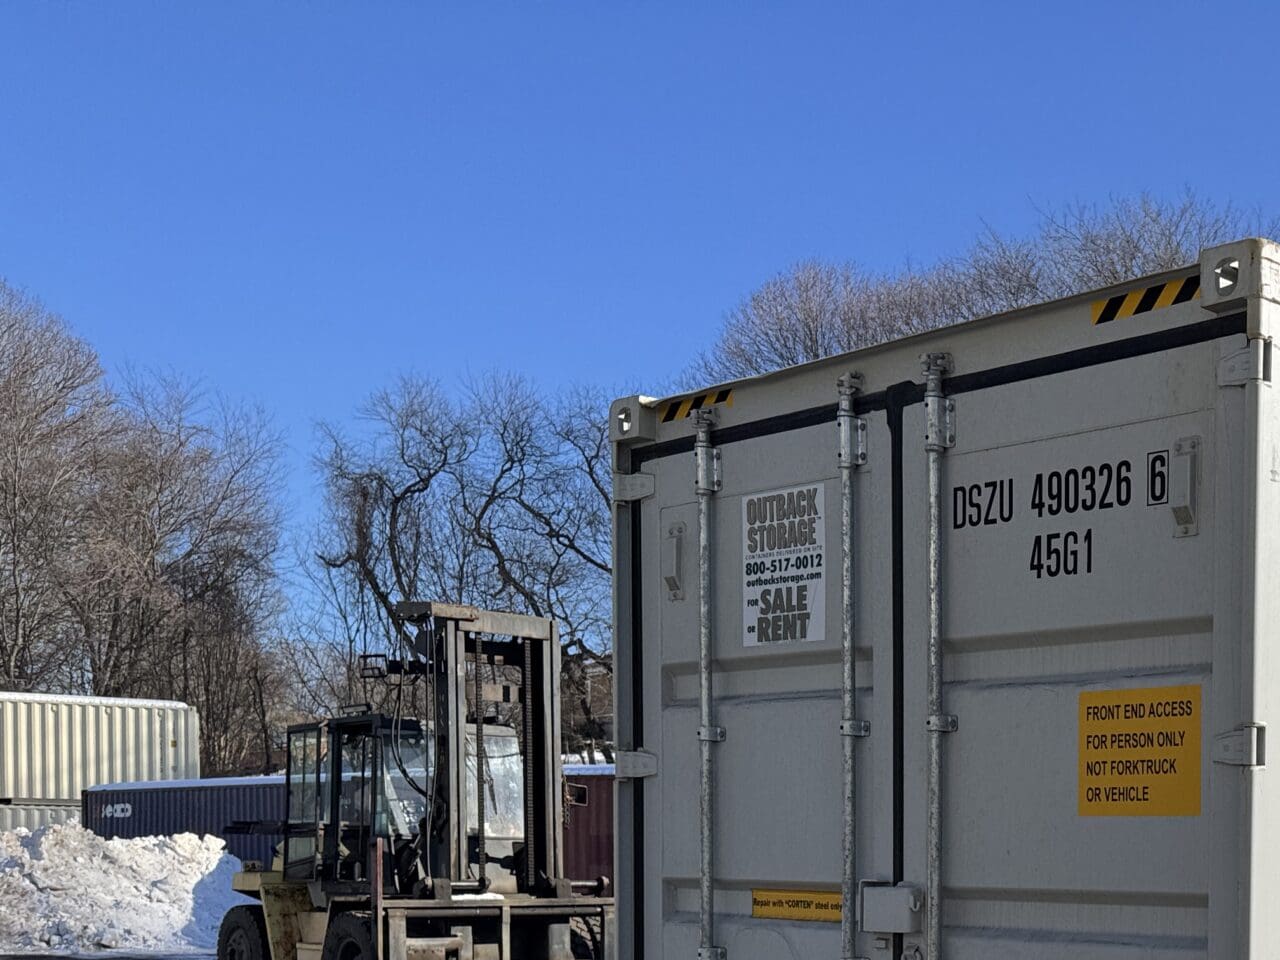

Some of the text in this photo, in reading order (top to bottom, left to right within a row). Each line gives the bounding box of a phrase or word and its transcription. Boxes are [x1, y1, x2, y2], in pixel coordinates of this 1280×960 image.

[953, 452, 1167, 529] DSZU 490326 6
[746, 488, 818, 525] OUTBACK
[747, 517, 817, 553] STORAGE
[1030, 528, 1092, 579] 45G1
[746, 554, 822, 576] 800-517-0012
[746, 571, 821, 587] outbackstorage.com
[747, 584, 807, 616] FOR SALE
[747, 612, 810, 643] OR RENT
[1086, 700, 1192, 721] FRONT END ACCESS
[1086, 731, 1185, 750] FOR PERSON ONLY
[1086, 758, 1177, 776] NOT FORKTRUCK
[1086, 786, 1149, 802] OR VEHICLE
[752, 898, 770, 908] Repair
[815, 901, 829, 909] steel
[830, 902, 842, 912] only
